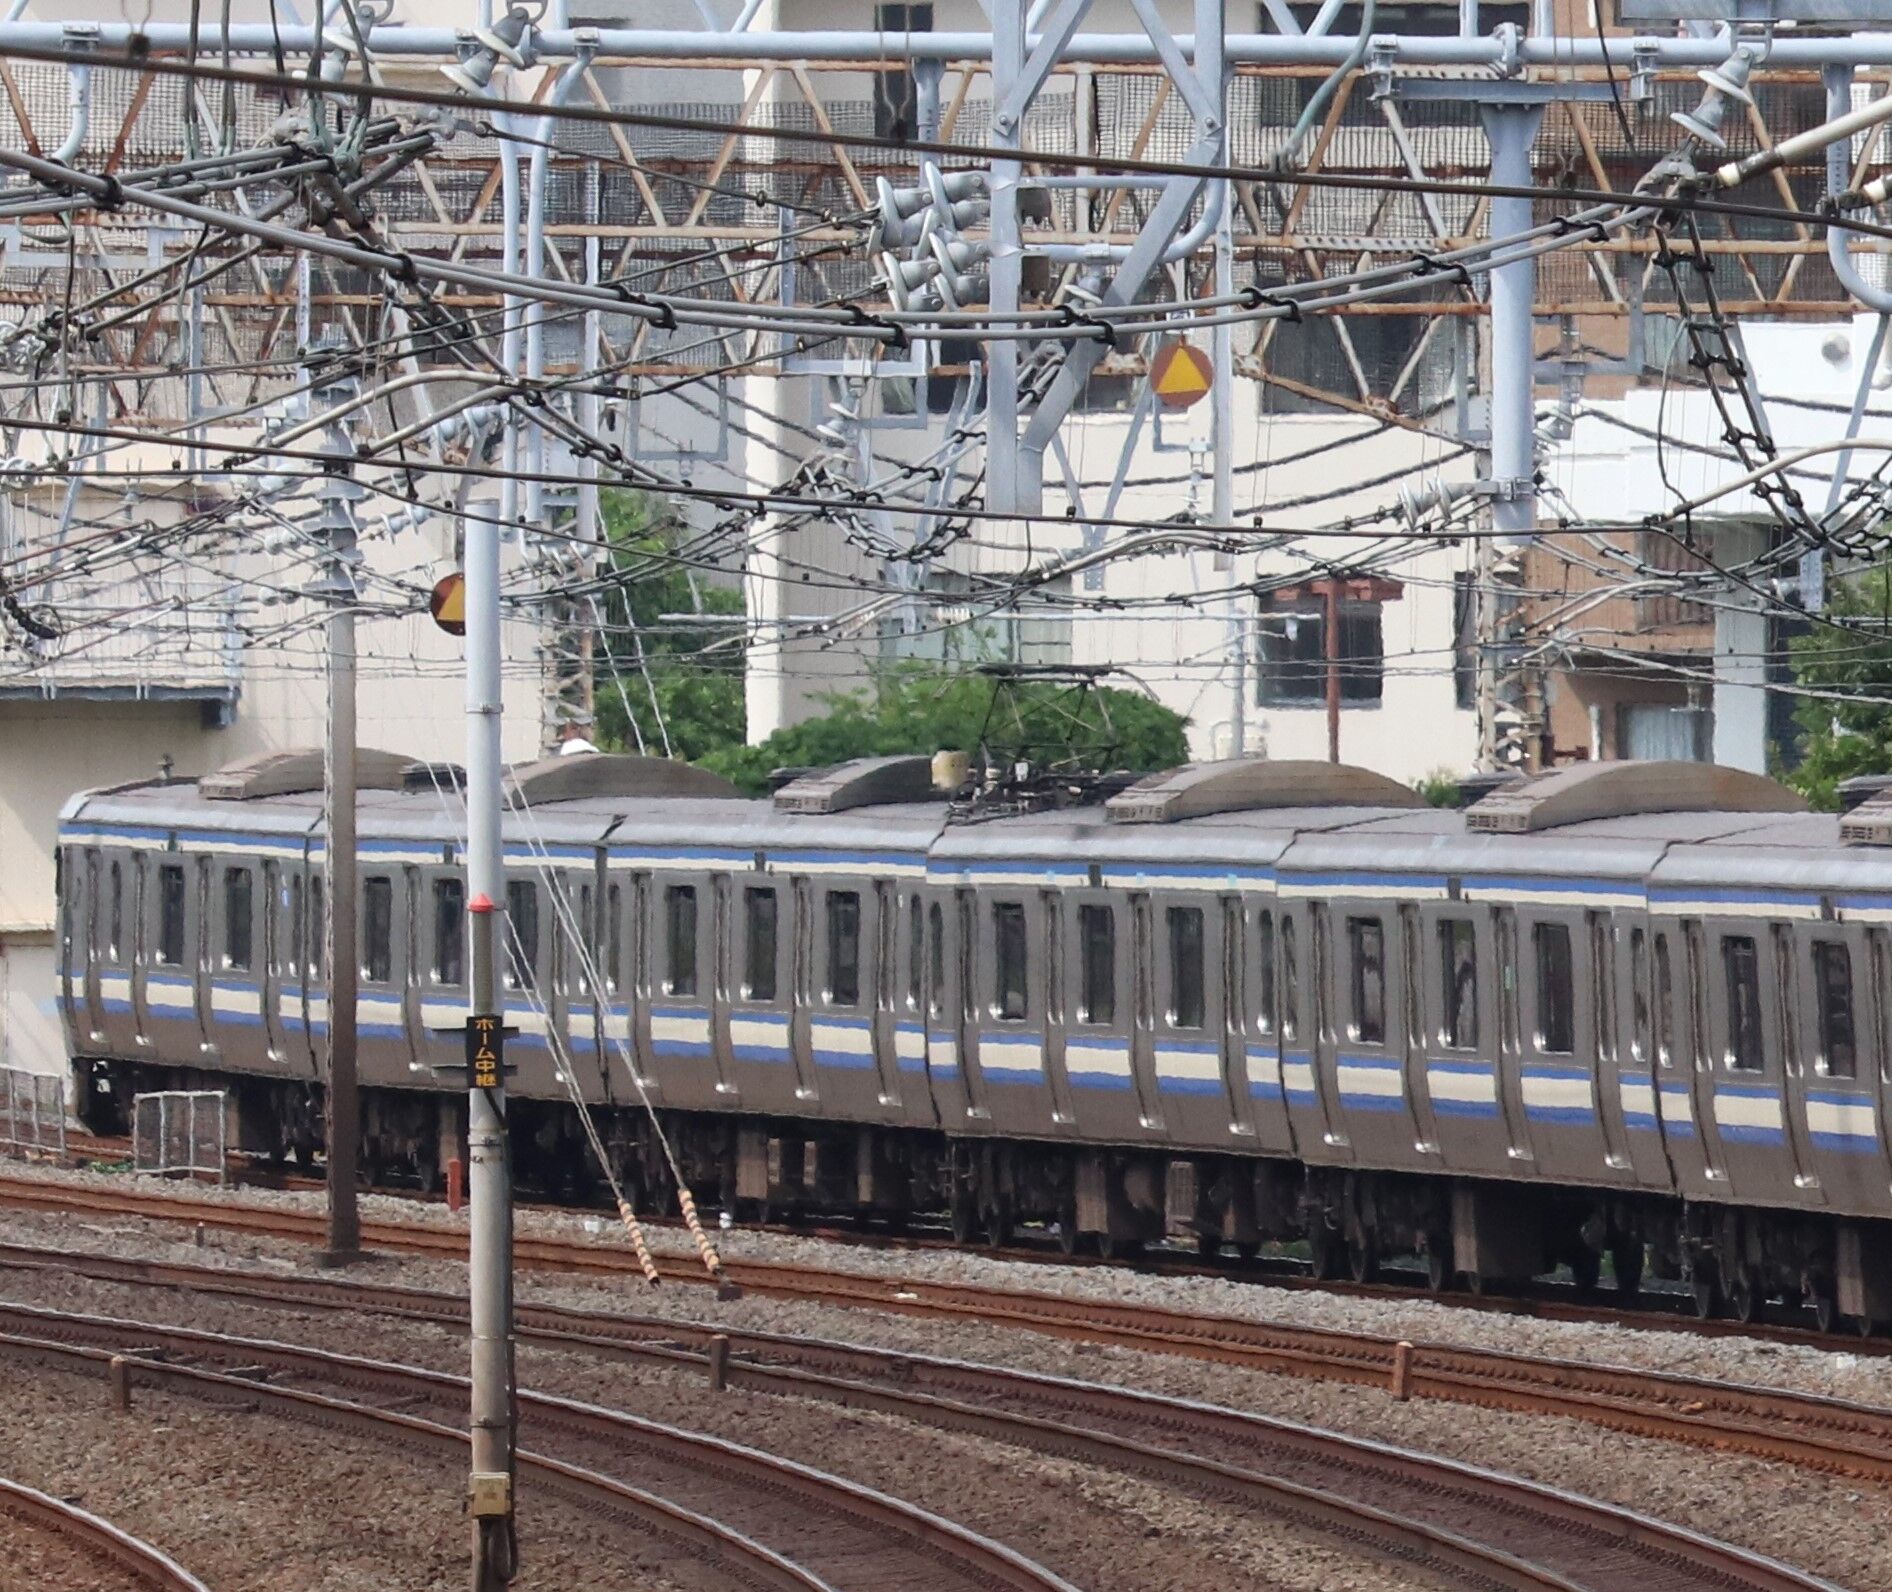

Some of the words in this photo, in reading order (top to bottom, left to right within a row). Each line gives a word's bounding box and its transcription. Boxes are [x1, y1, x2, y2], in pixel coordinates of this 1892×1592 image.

[475, 1018, 497, 1086] ホーム中継
